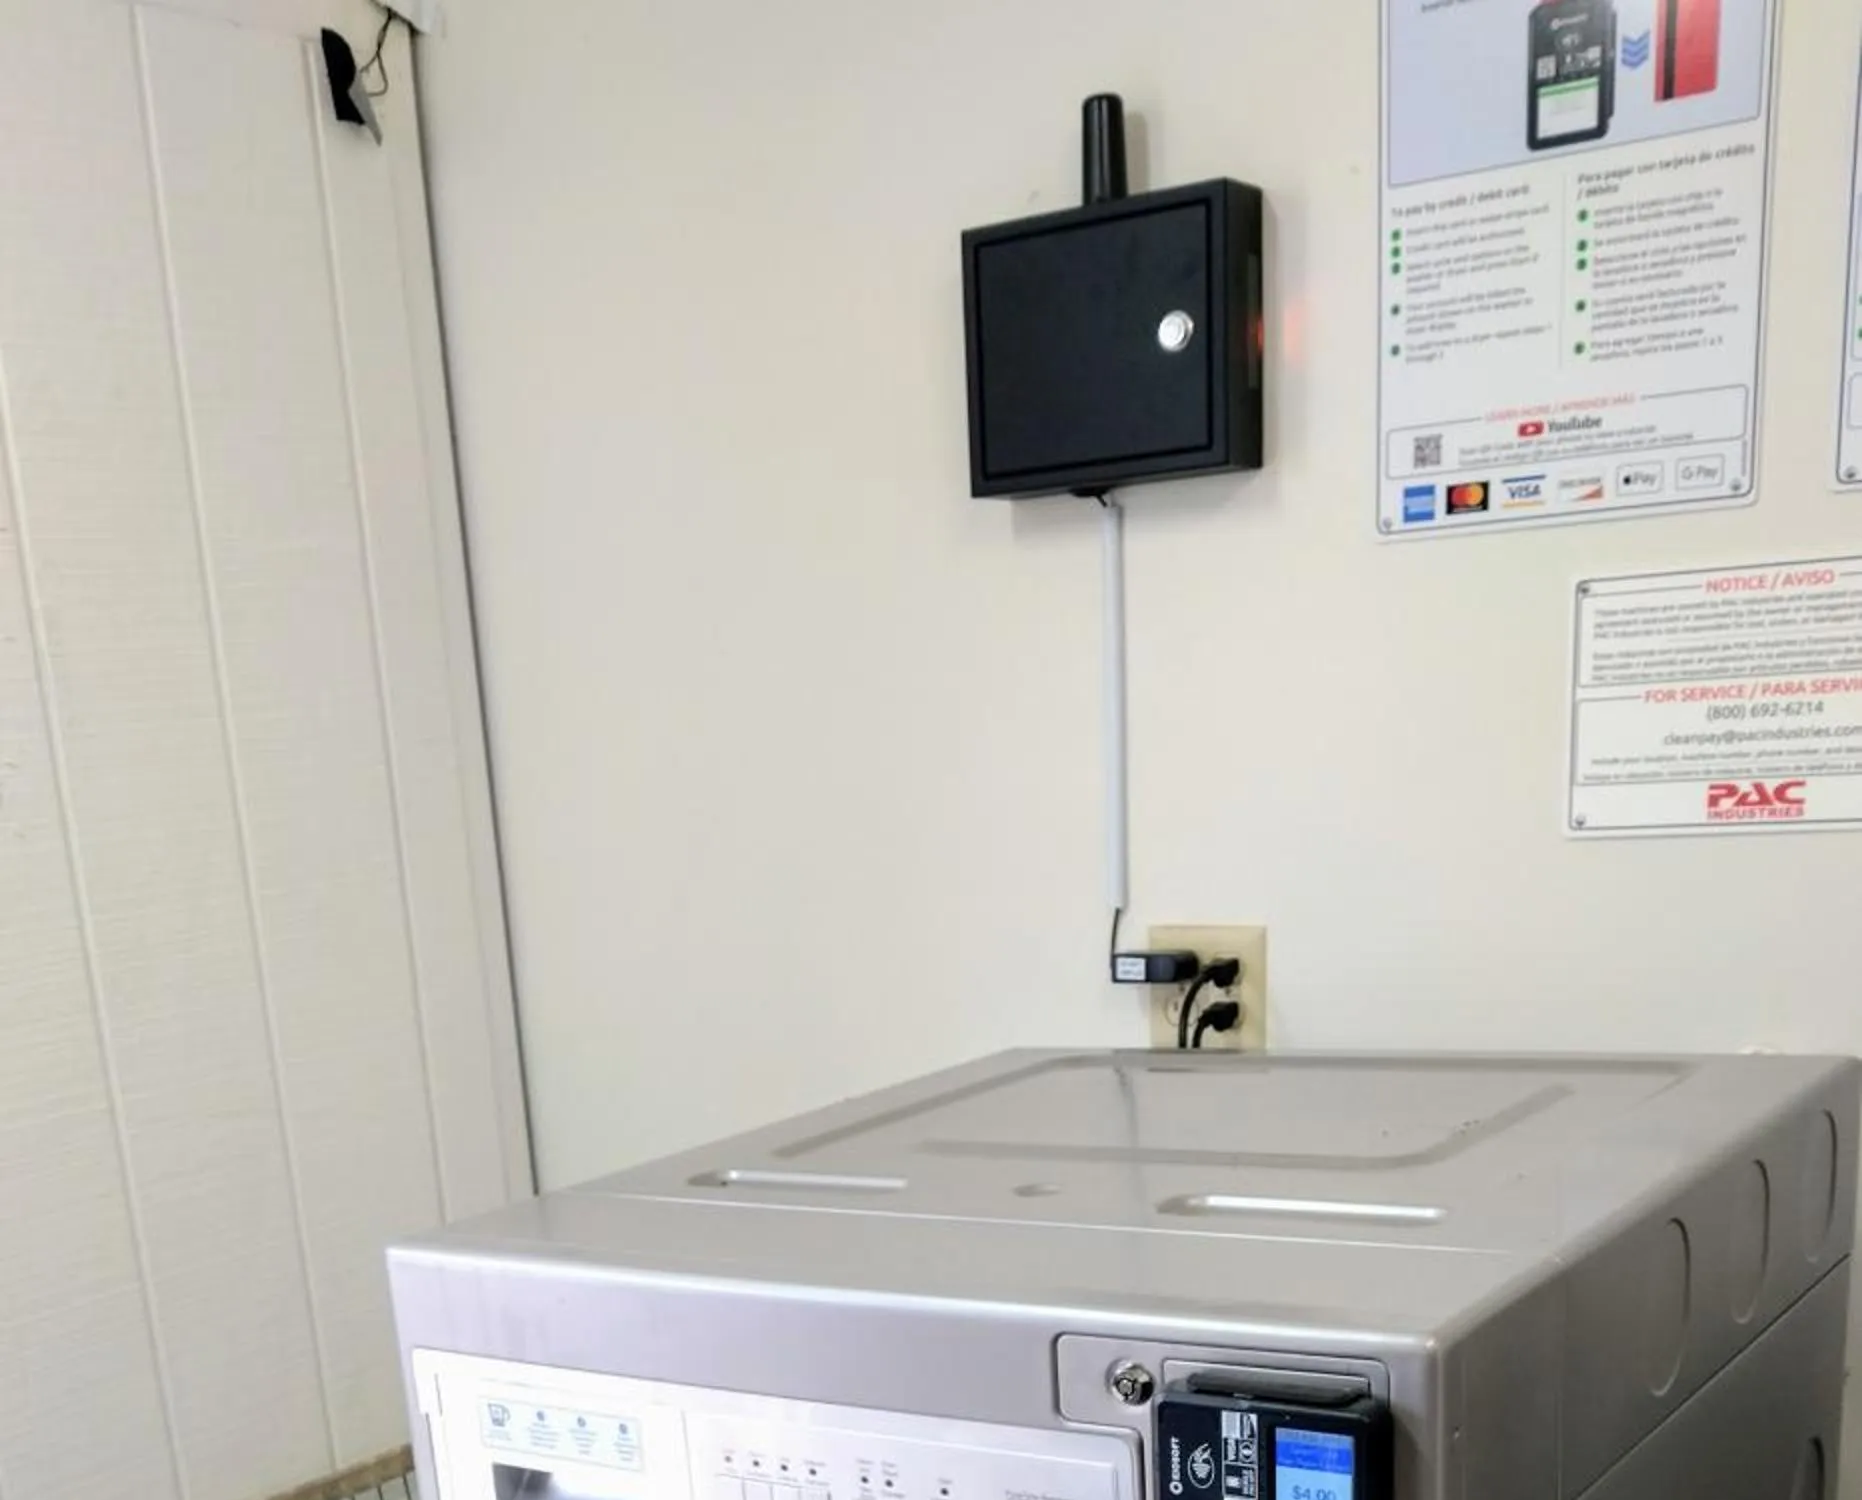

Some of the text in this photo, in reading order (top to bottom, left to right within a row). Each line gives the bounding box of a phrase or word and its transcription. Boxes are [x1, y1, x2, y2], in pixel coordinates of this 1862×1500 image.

[1548, 416, 1602, 431] YouTube
[1508, 484, 1541, 499] VISA
[1705, 574, 1767, 593] NOTICE
[1782, 568, 1835, 587] AVISO
[1645, 689, 1678, 703] FOR
[1681, 684, 1746, 702] SERVICE
[1761, 680, 1806, 696] PARA
[1707, 700, 1824, 721] (800) 692-6214
[1708, 780, 1806, 808] PAC
[1707, 807, 1804, 820] INDUSTRIES
